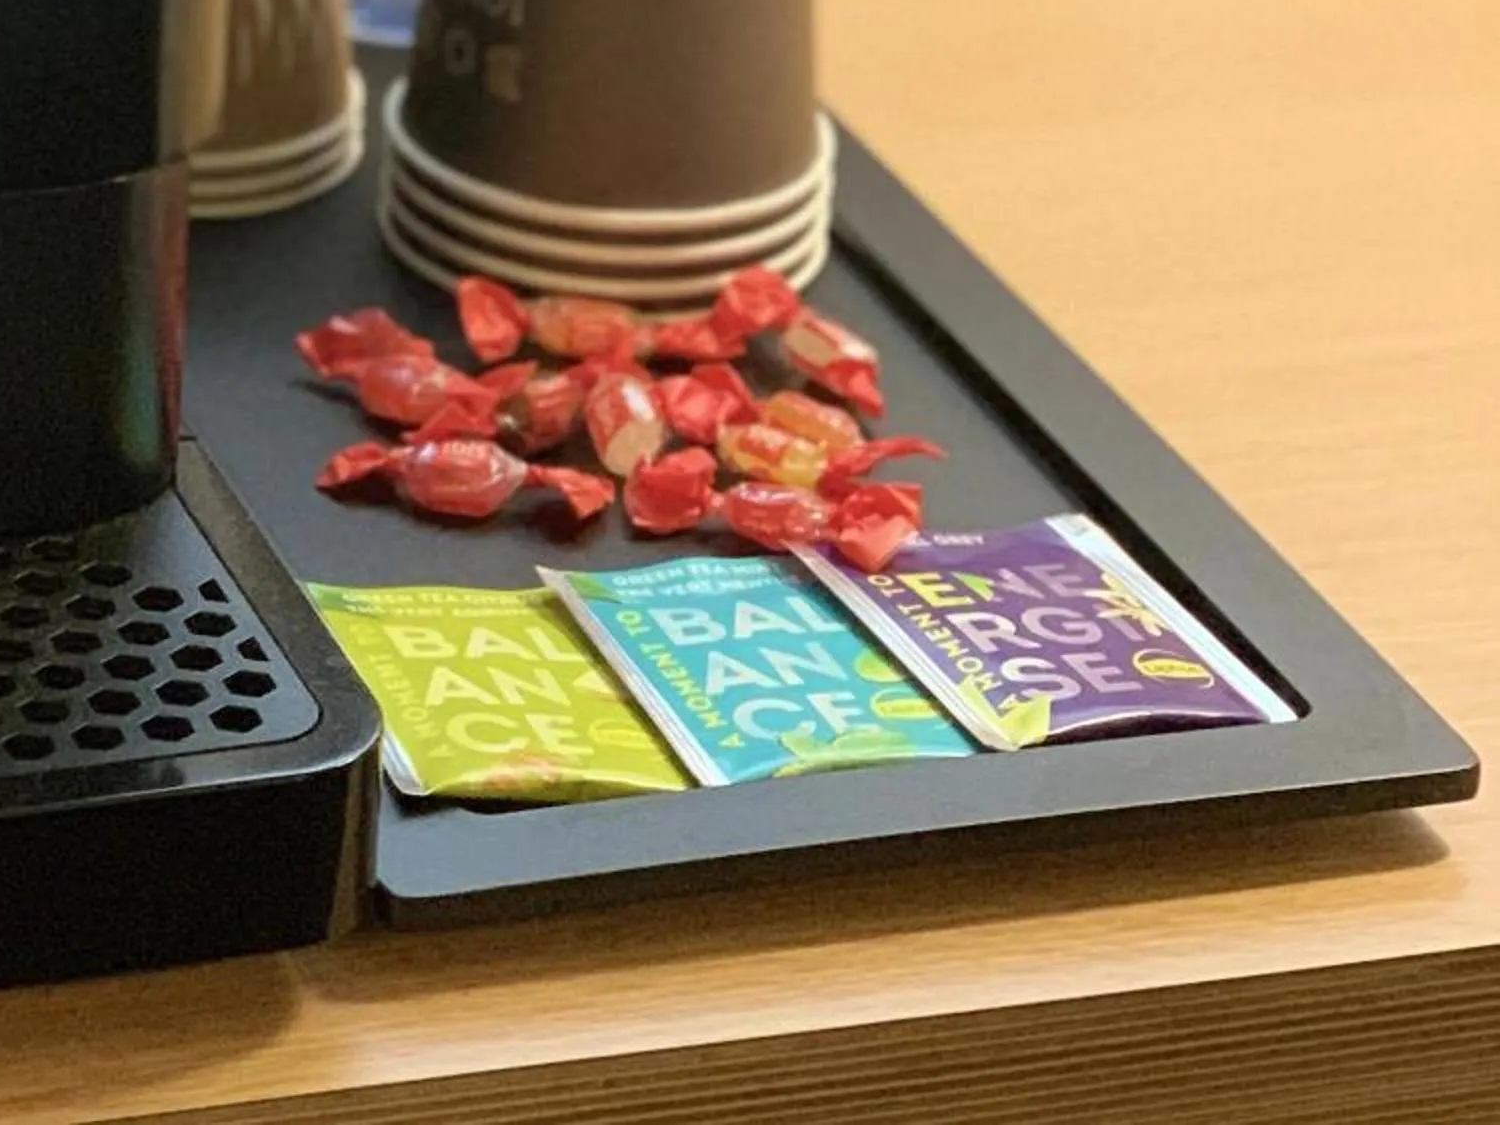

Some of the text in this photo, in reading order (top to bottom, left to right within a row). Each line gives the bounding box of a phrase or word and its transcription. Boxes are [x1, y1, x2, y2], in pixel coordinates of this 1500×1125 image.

[867, 575, 905, 598] TO
[382, 625, 590, 662] BAL
[615, 610, 651, 636] TO
[647, 596, 847, 646] BAL
[705, 641, 847, 696] AN
[897, 603, 1002, 693] MOMENT
[366, 654, 441, 739] MOMENT
[422, 665, 572, 708] AN
[639, 642, 729, 729] MOMENT
[1001, 651, 1145, 702] SE
[445, 712, 595, 755] CE
[731, 691, 879, 740] CE
[718, 733, 747, 749] A
